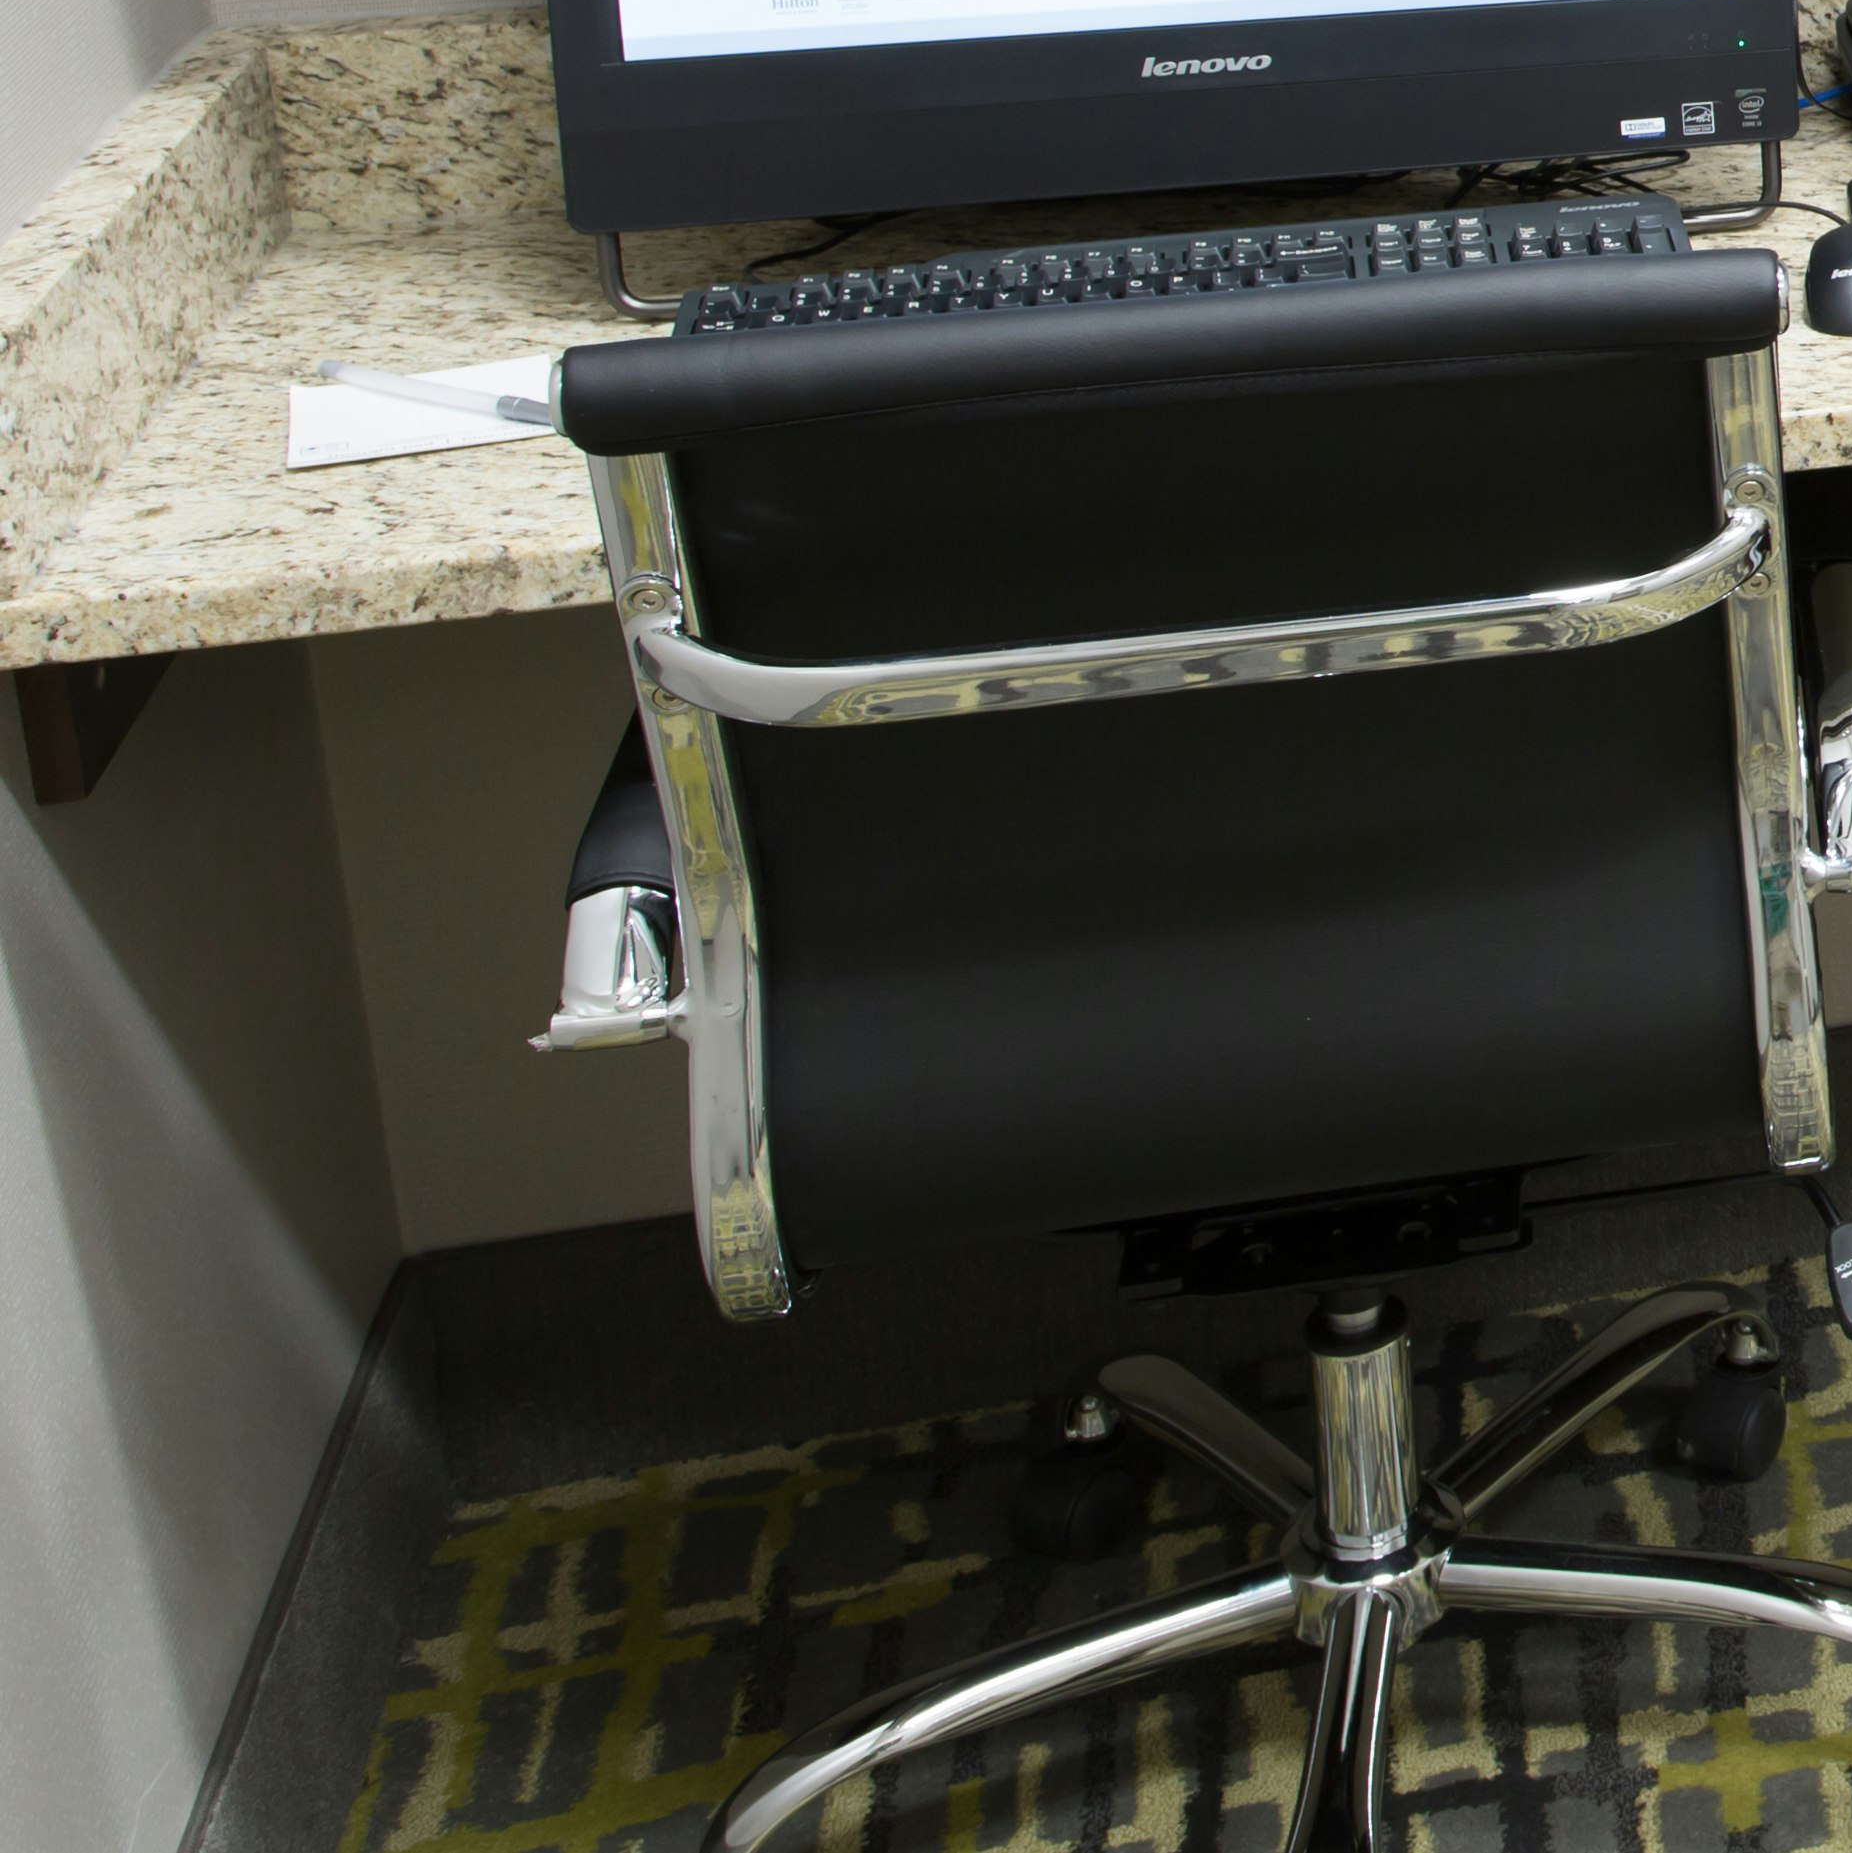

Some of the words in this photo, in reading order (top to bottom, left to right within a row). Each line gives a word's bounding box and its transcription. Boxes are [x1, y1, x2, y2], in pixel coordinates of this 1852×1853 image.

[1141, 54, 1273, 78] lenovo
[818, 309, 831, 317] W
[999, 292, 1010, 300] Y
[1042, 288, 1054, 296] U
